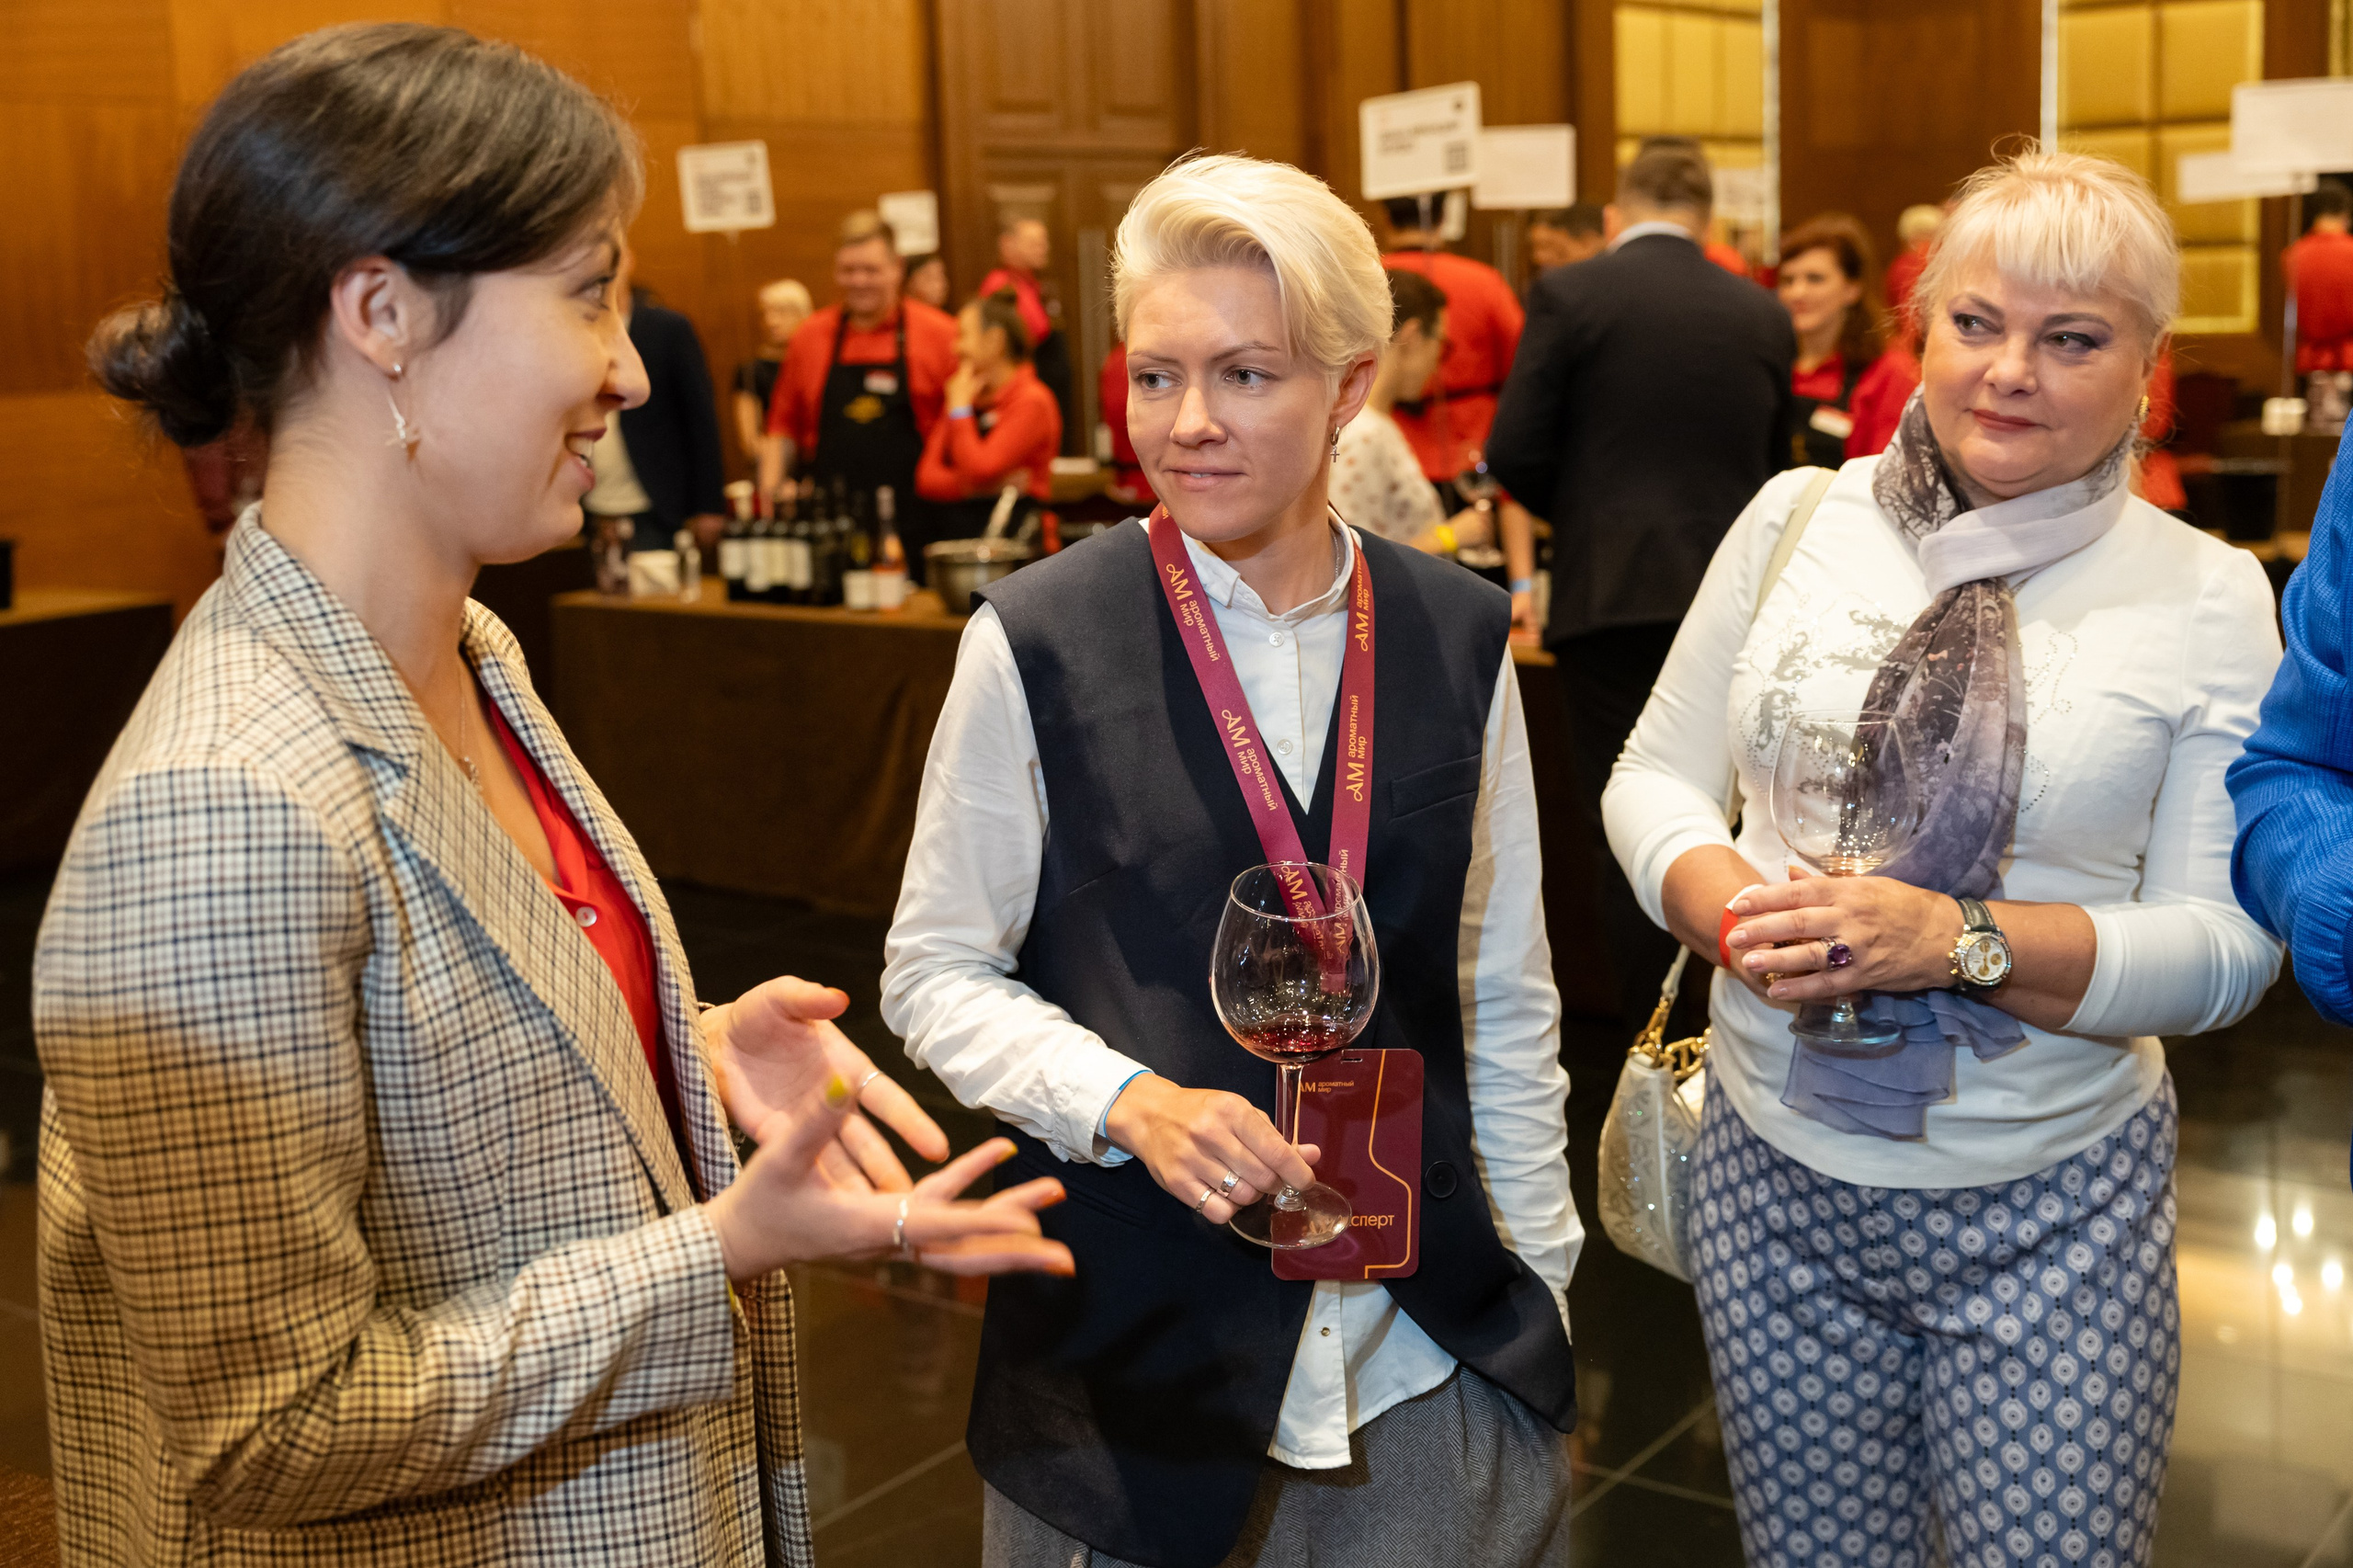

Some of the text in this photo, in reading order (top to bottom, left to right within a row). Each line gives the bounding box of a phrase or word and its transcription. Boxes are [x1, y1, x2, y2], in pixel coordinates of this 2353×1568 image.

[1165, 563, 1194, 600] АМ
[1179, 603, 1194, 627] мир
[1188, 599, 1219, 662] ароматный
[1355, 611, 1370, 652] АМ
[1222, 710, 1251, 748] АМ
[1347, 695, 1358, 758] ароматный
[1237, 751, 1252, 775] мир
[1358, 736, 1368, 759] мир
[1246, 747, 1278, 811] ароматный
[1346, 762, 1365, 801] АМ
[1350, 1214, 1395, 1230] сперт
